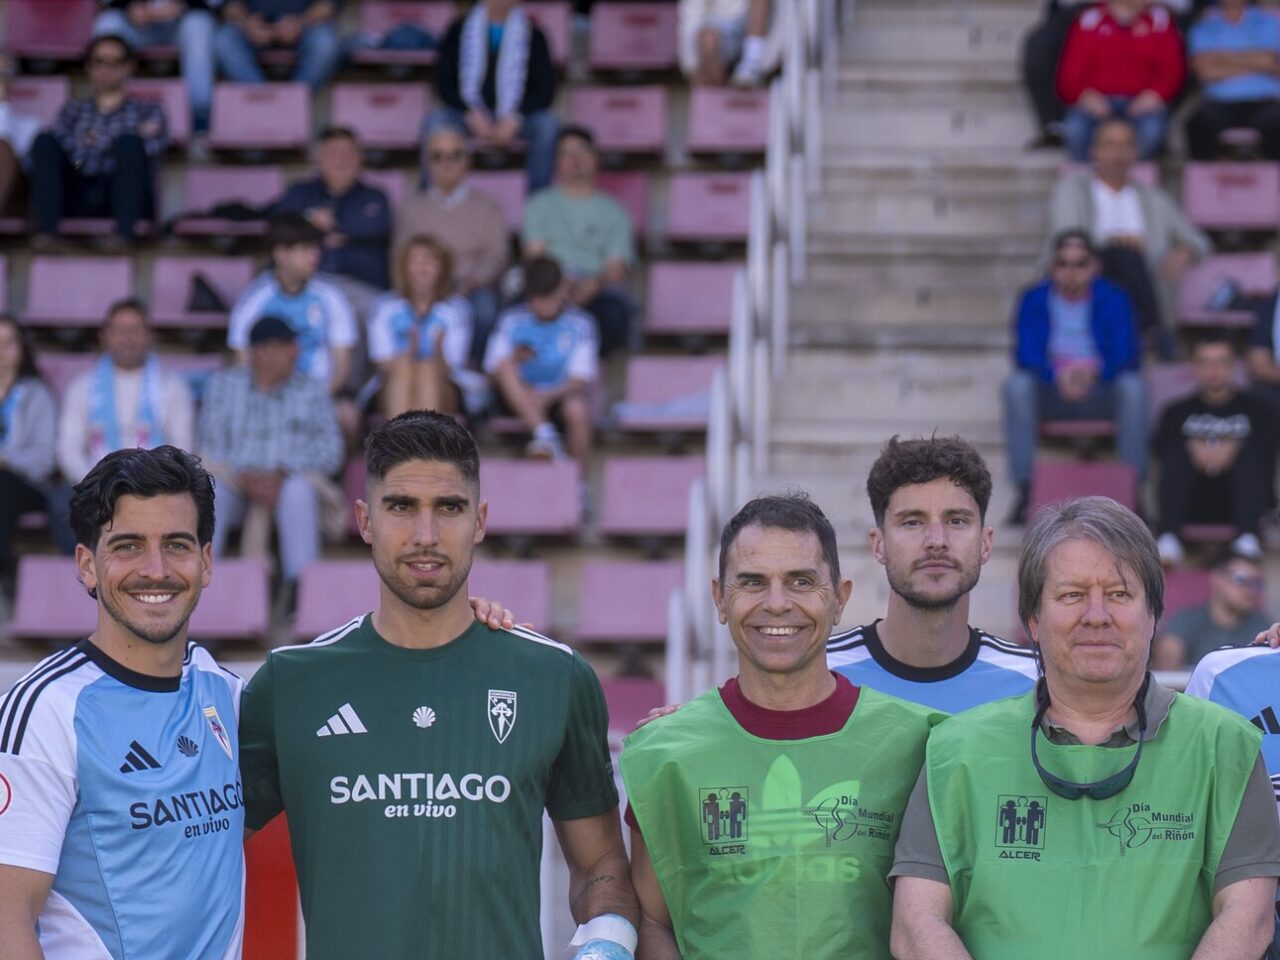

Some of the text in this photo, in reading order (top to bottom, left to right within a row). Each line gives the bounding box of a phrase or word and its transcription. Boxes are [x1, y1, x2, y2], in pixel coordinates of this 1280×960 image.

[330, 773, 511, 804] SANTIAGO
[384, 800, 456, 818] en vivo
[1133, 803, 1151, 814] Día
[858, 808, 895, 824] Mundial
[1152, 812, 1195, 824] Mundial
[184, 816, 230, 839] en vivo
[1152, 830, 1195, 842] del Riñón
[709, 845, 746, 857] ALCER
[998, 850, 1042, 862] ALCER
